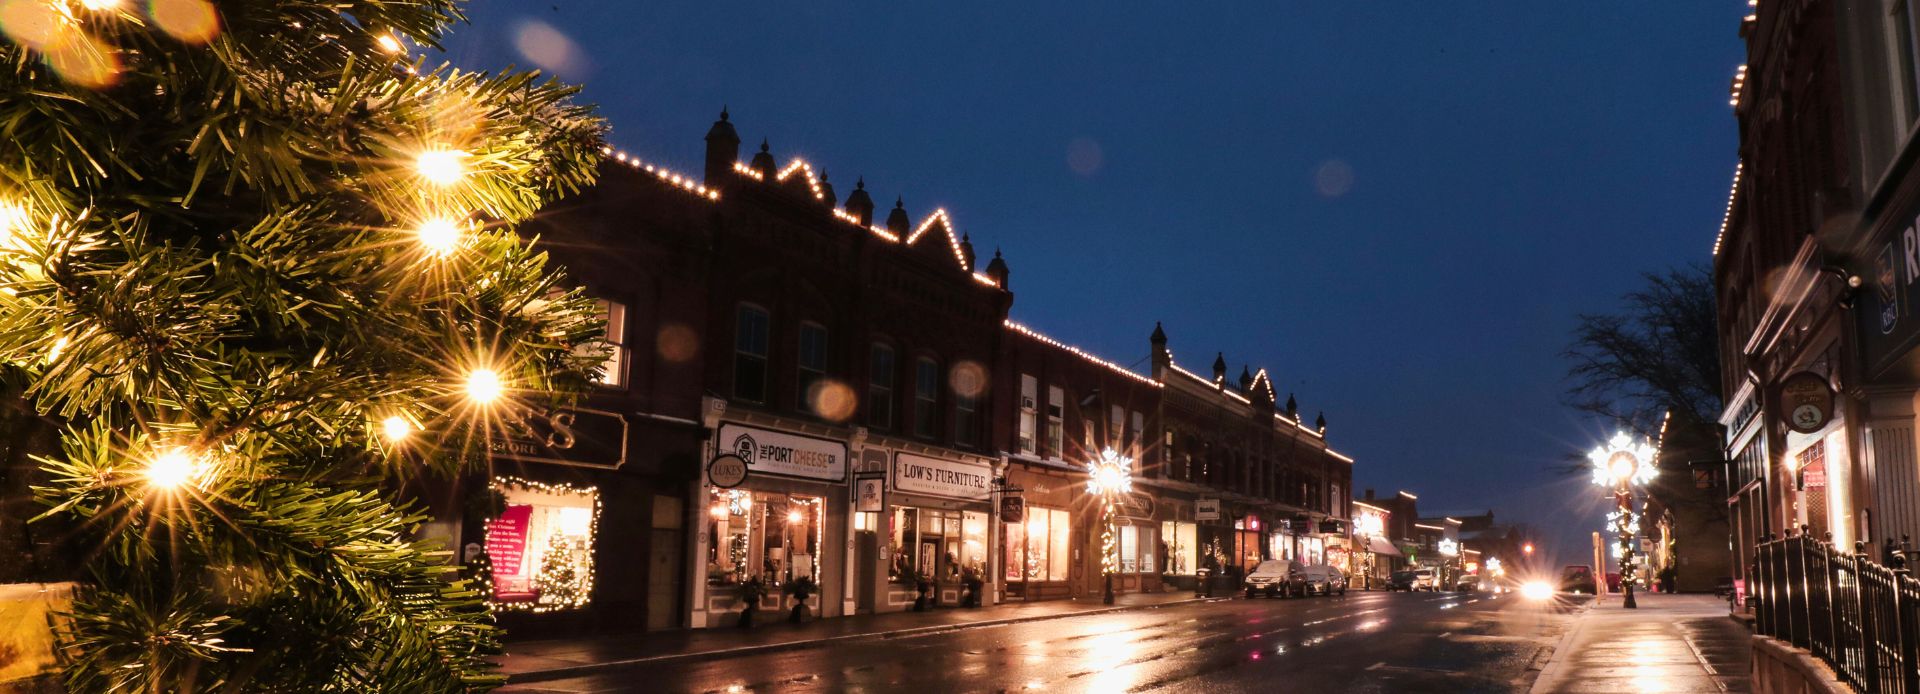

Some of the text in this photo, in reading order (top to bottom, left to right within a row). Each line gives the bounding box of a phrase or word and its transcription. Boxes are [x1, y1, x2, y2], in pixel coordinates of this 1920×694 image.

[1903, 213, 1920, 285] R
[1882, 303, 1896, 327] RBC
[760, 444, 769, 460] THE
[768, 445, 794, 463] PORT
[794, 448, 829, 468] CHEESE
[828, 454, 836, 464] CO
[904, 463, 933, 481] LOW'S
[935, 468, 986, 489] FURNITURE
